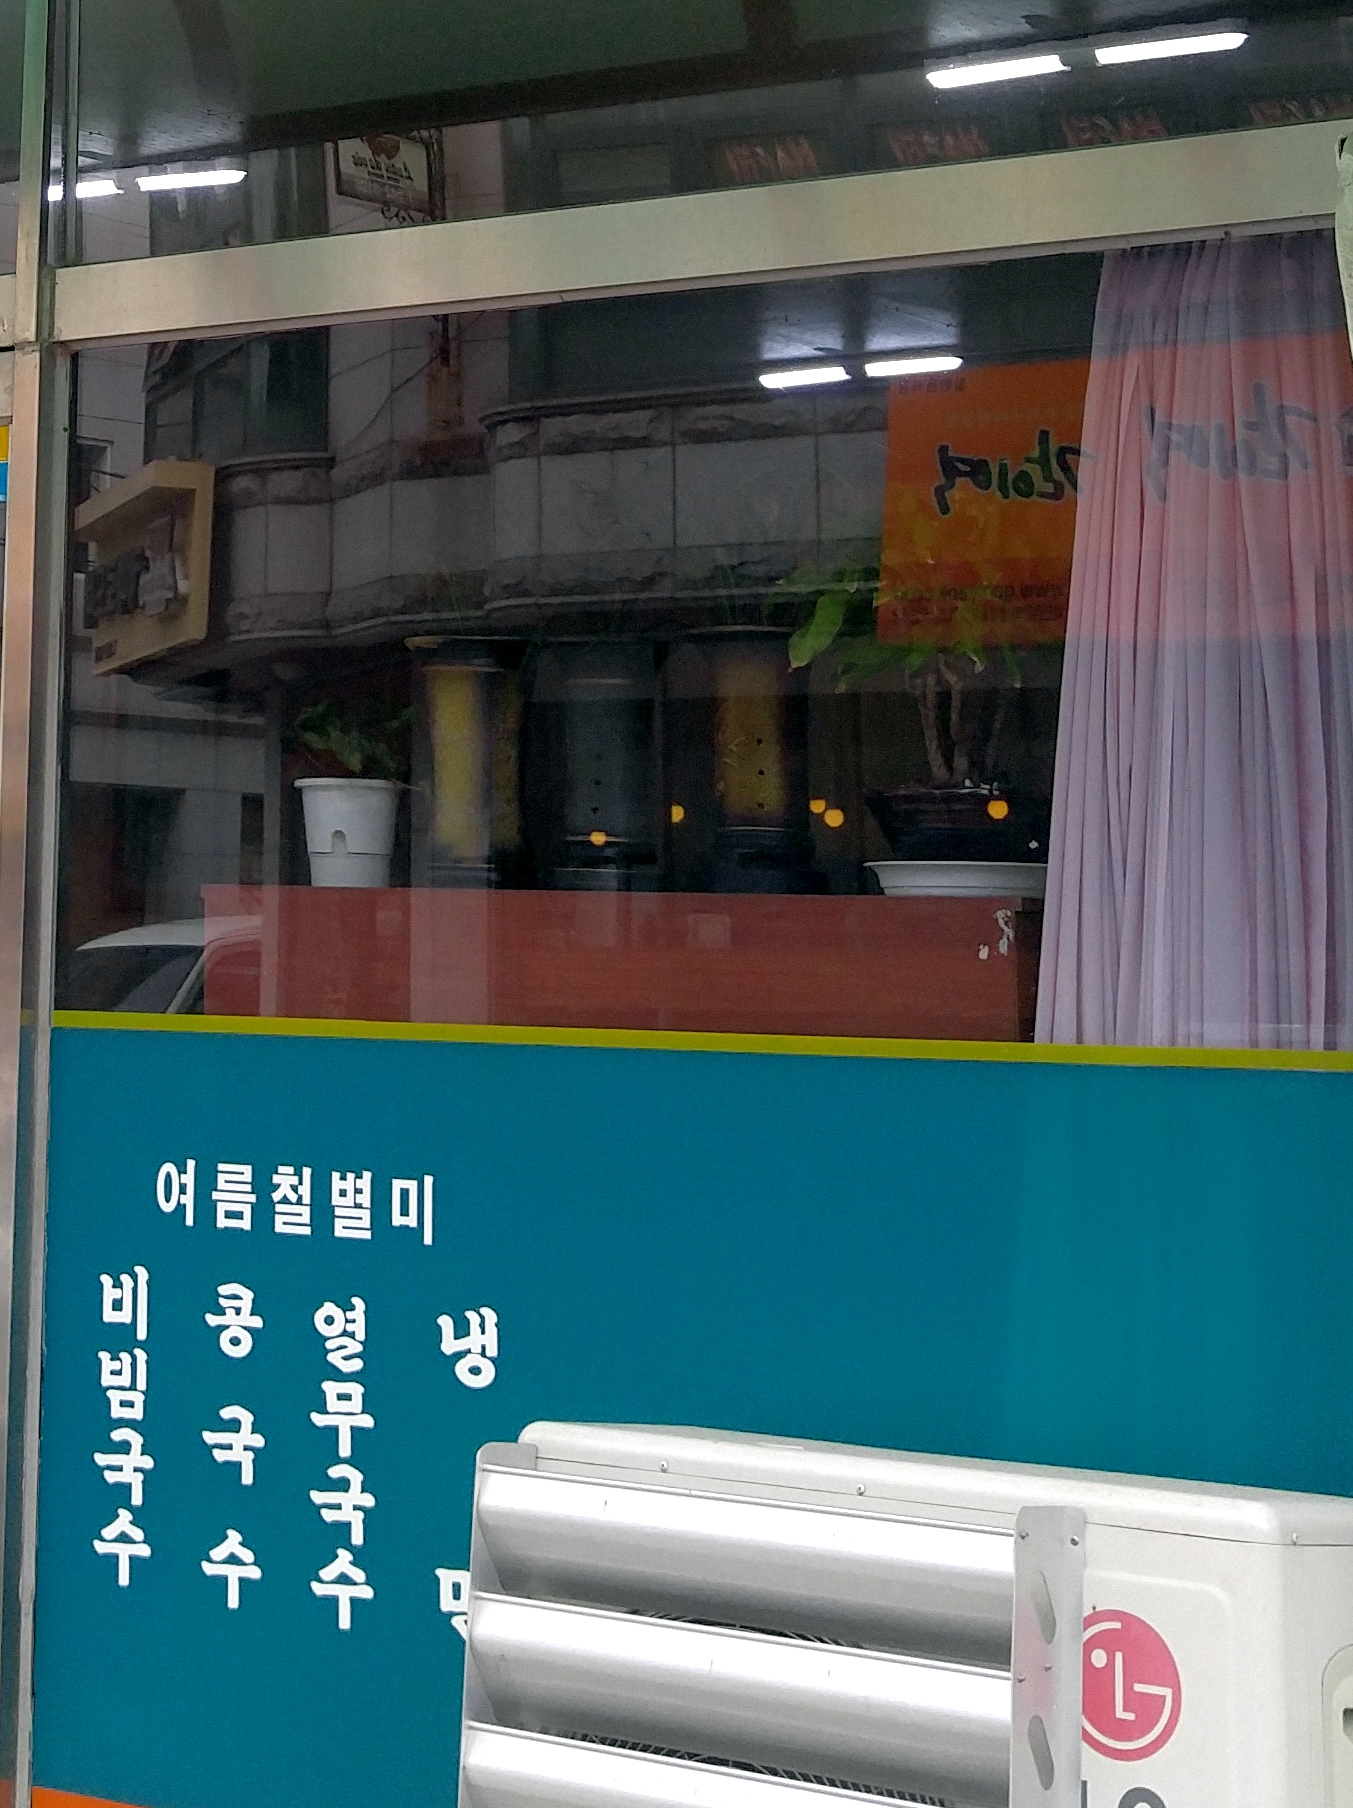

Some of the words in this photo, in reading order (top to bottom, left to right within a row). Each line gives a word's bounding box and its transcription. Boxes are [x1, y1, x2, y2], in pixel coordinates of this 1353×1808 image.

[156, 1158, 435, 1246] 여름철별미
[93, 1264, 155, 1588] 비빔국수
[200, 1282, 266, 1611] 콩국수
[309, 1295, 376, 1631] 열무국수
